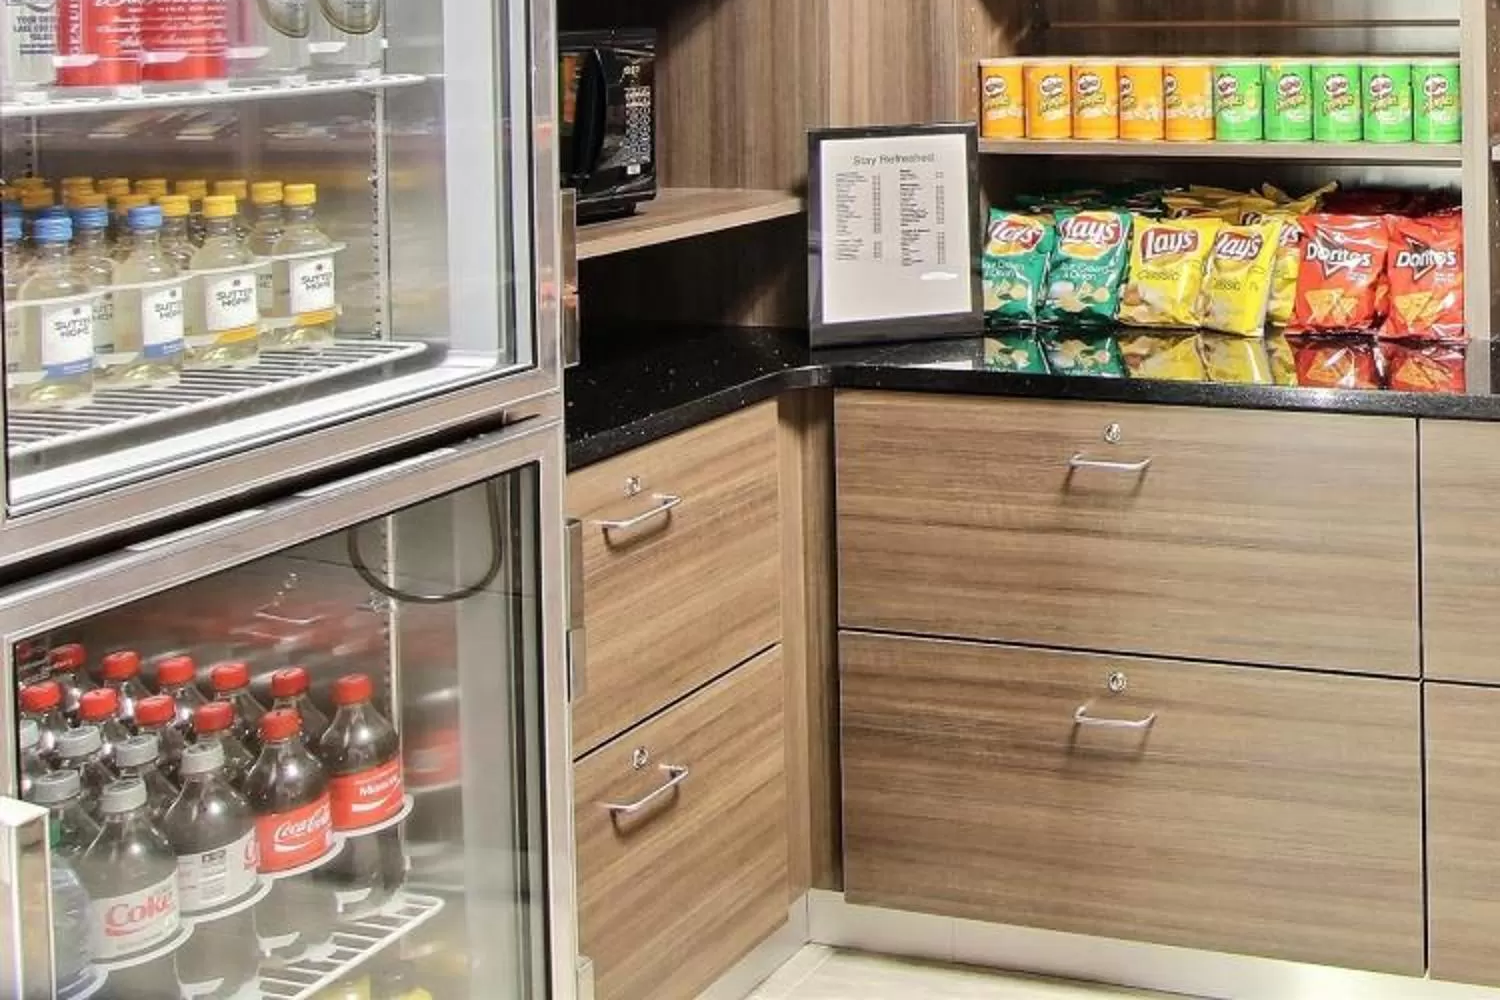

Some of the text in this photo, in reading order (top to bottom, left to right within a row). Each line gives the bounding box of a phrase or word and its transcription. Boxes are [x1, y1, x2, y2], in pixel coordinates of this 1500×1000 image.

[854, 151, 934, 167] Stay Refreshed
[1306, 243, 1372, 267] Doritos
[1396, 250, 1456, 267] Doritos
[105, 892, 173, 927] Coke
